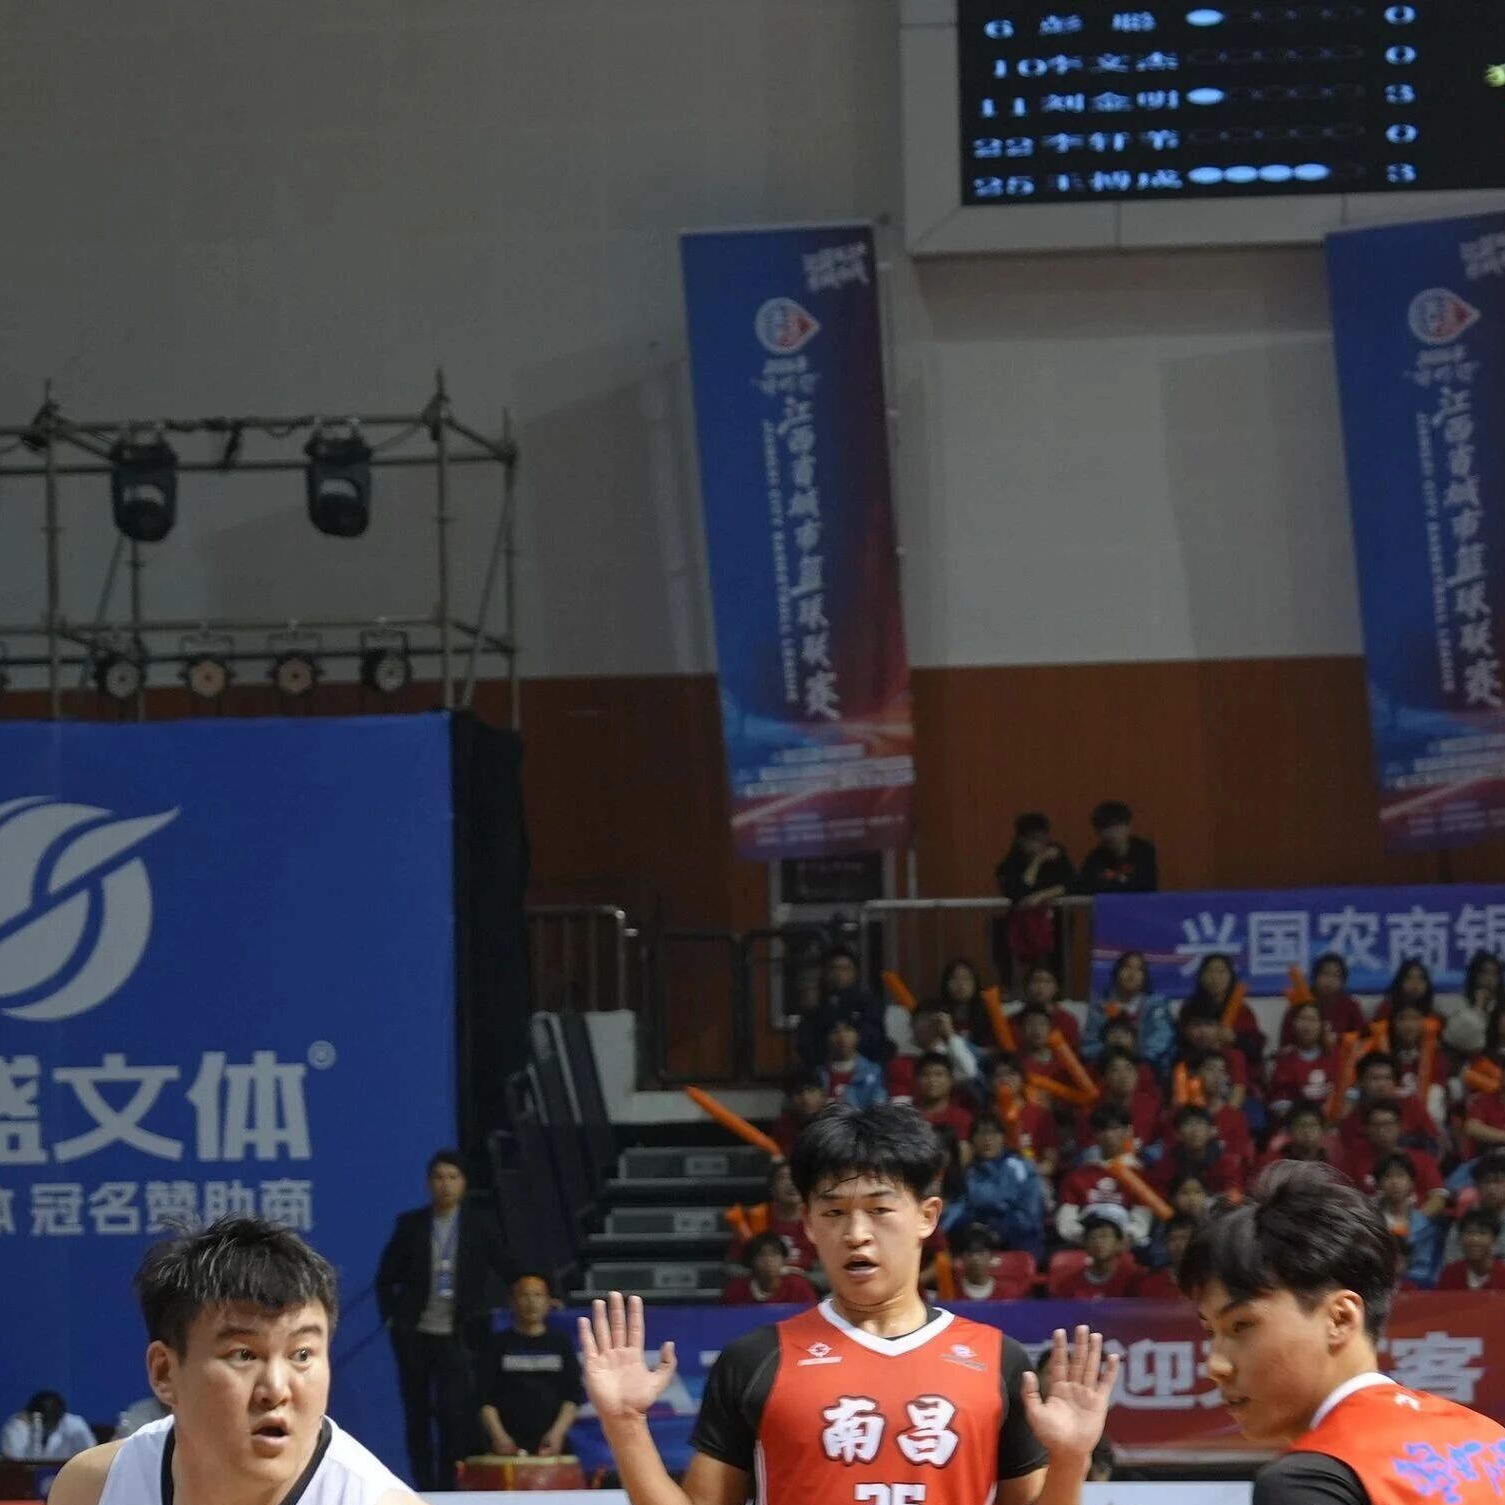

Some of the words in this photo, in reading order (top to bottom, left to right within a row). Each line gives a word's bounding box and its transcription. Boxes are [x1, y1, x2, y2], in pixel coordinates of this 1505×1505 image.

[1384, 6, 1416, 25] 0
[1385, 45, 1417, 65] 0
[1385, 123, 1418, 144] 0
[822, 1395, 959, 1467] 南昌
